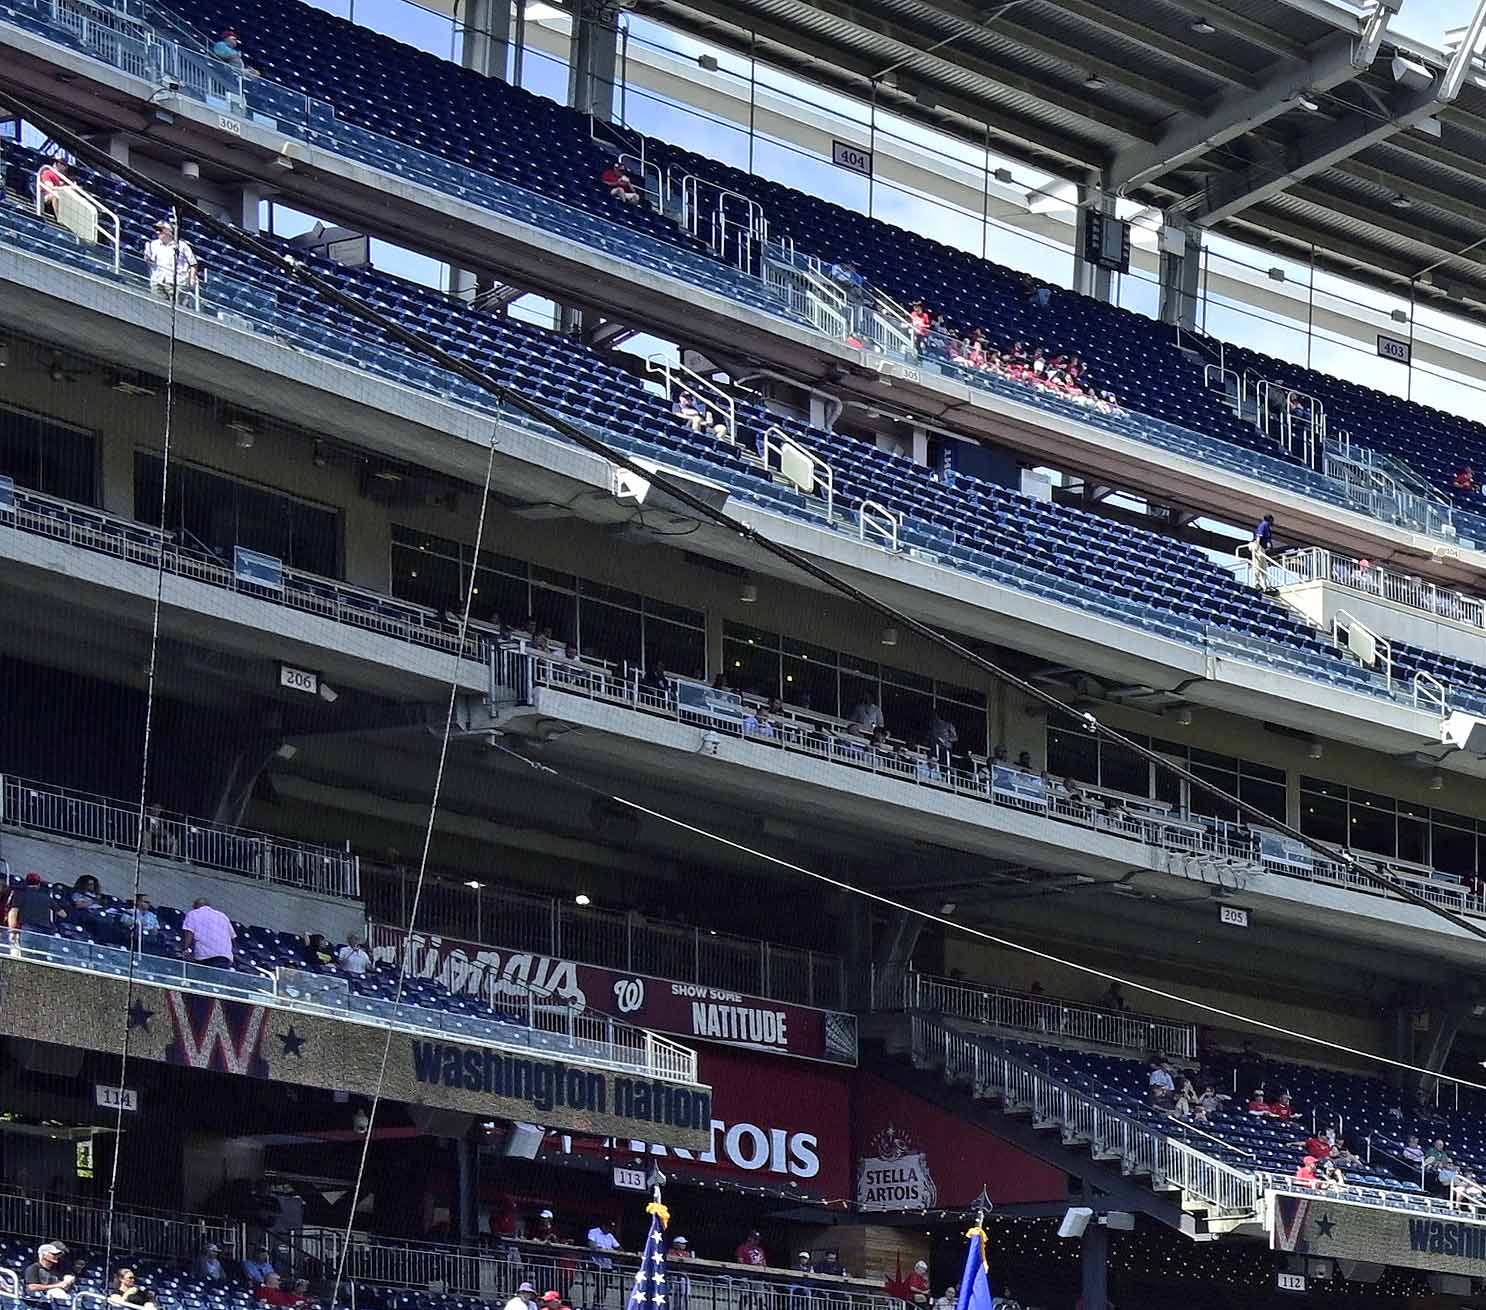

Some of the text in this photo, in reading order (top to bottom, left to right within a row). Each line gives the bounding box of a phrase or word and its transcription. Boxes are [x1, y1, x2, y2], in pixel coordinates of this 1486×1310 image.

[221, 119, 239, 132] 306
[840, 149, 864, 168] 404
[1382, 343, 1404, 357] 403
[287, 671, 310, 688] 206
[1225, 911, 1244, 925] 205
[672, 983, 741, 1002] SHOW SOME
[692, 1001, 787, 1046] NATITUDE
[168, 990, 270, 1078] W
[104, 1091, 131, 1110] 114
[619, 1173, 641, 1187] 113
[866, 1168, 919, 1185] STELLA
[866, 1185, 919, 1202] ARTOIS
[1283, 1275, 1300, 1288] 112
